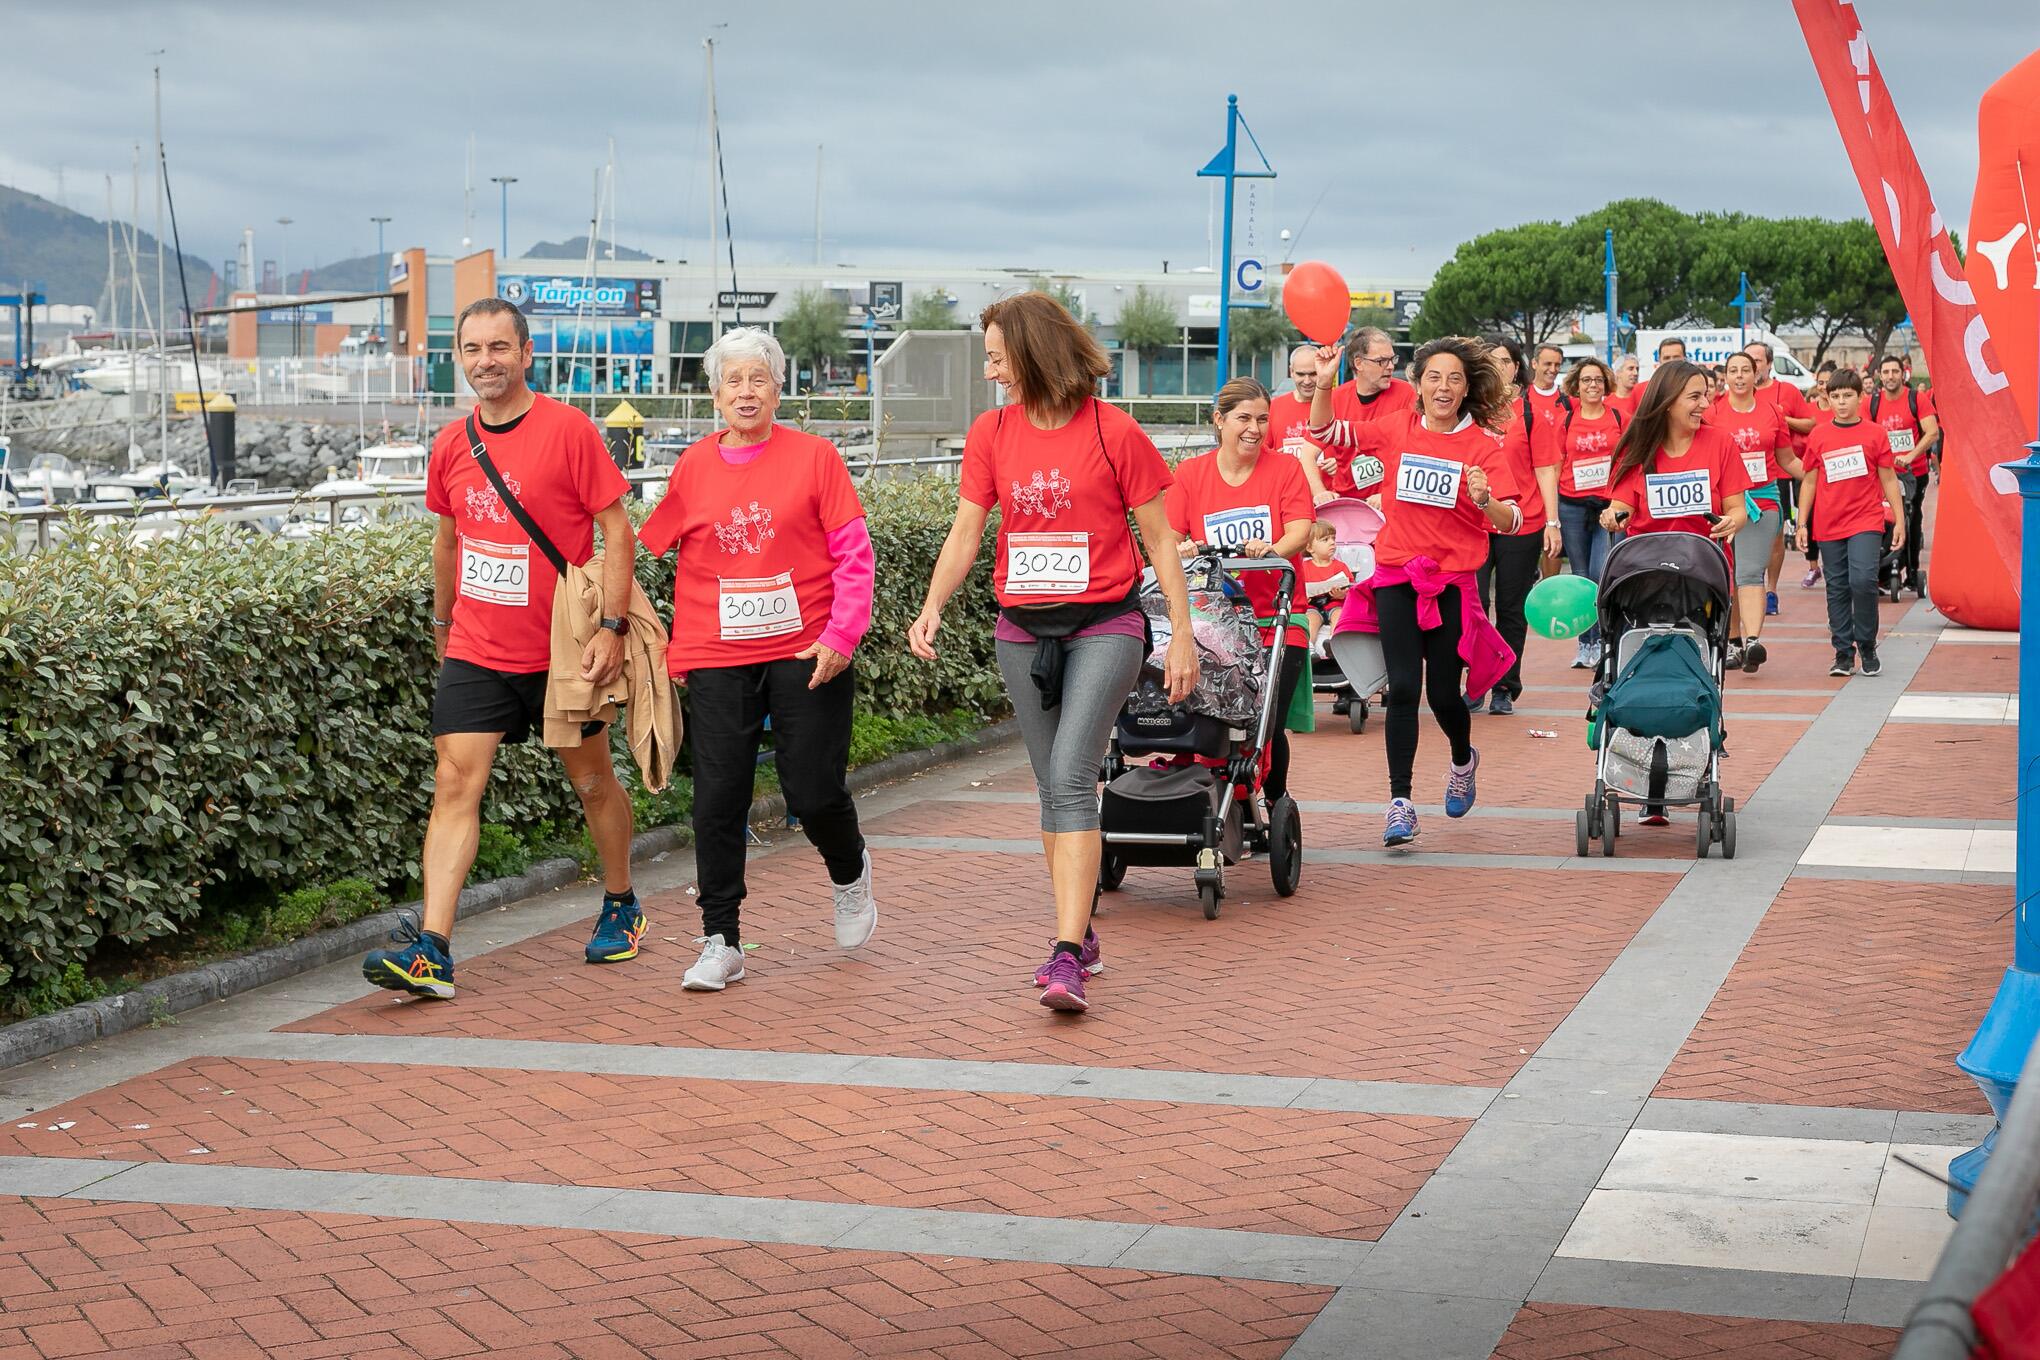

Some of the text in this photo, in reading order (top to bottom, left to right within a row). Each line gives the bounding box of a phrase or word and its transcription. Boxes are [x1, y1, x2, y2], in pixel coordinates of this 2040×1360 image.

[1248, 184, 1256, 247] PANTALAN
[1237, 259, 1263, 291] C
[533, 282, 626, 307] Tarpoon
[1691, 335, 1702, 343] 88
[1720, 335, 1732, 343] 43
[1404, 468, 1452, 495] 1008
[1655, 482, 1704, 506] 1008
[1213, 519, 1265, 546] 1008
[466, 554, 524, 585] 3020
[1014, 551, 1082, 576] 3020
[725, 596, 787, 619] 3020
